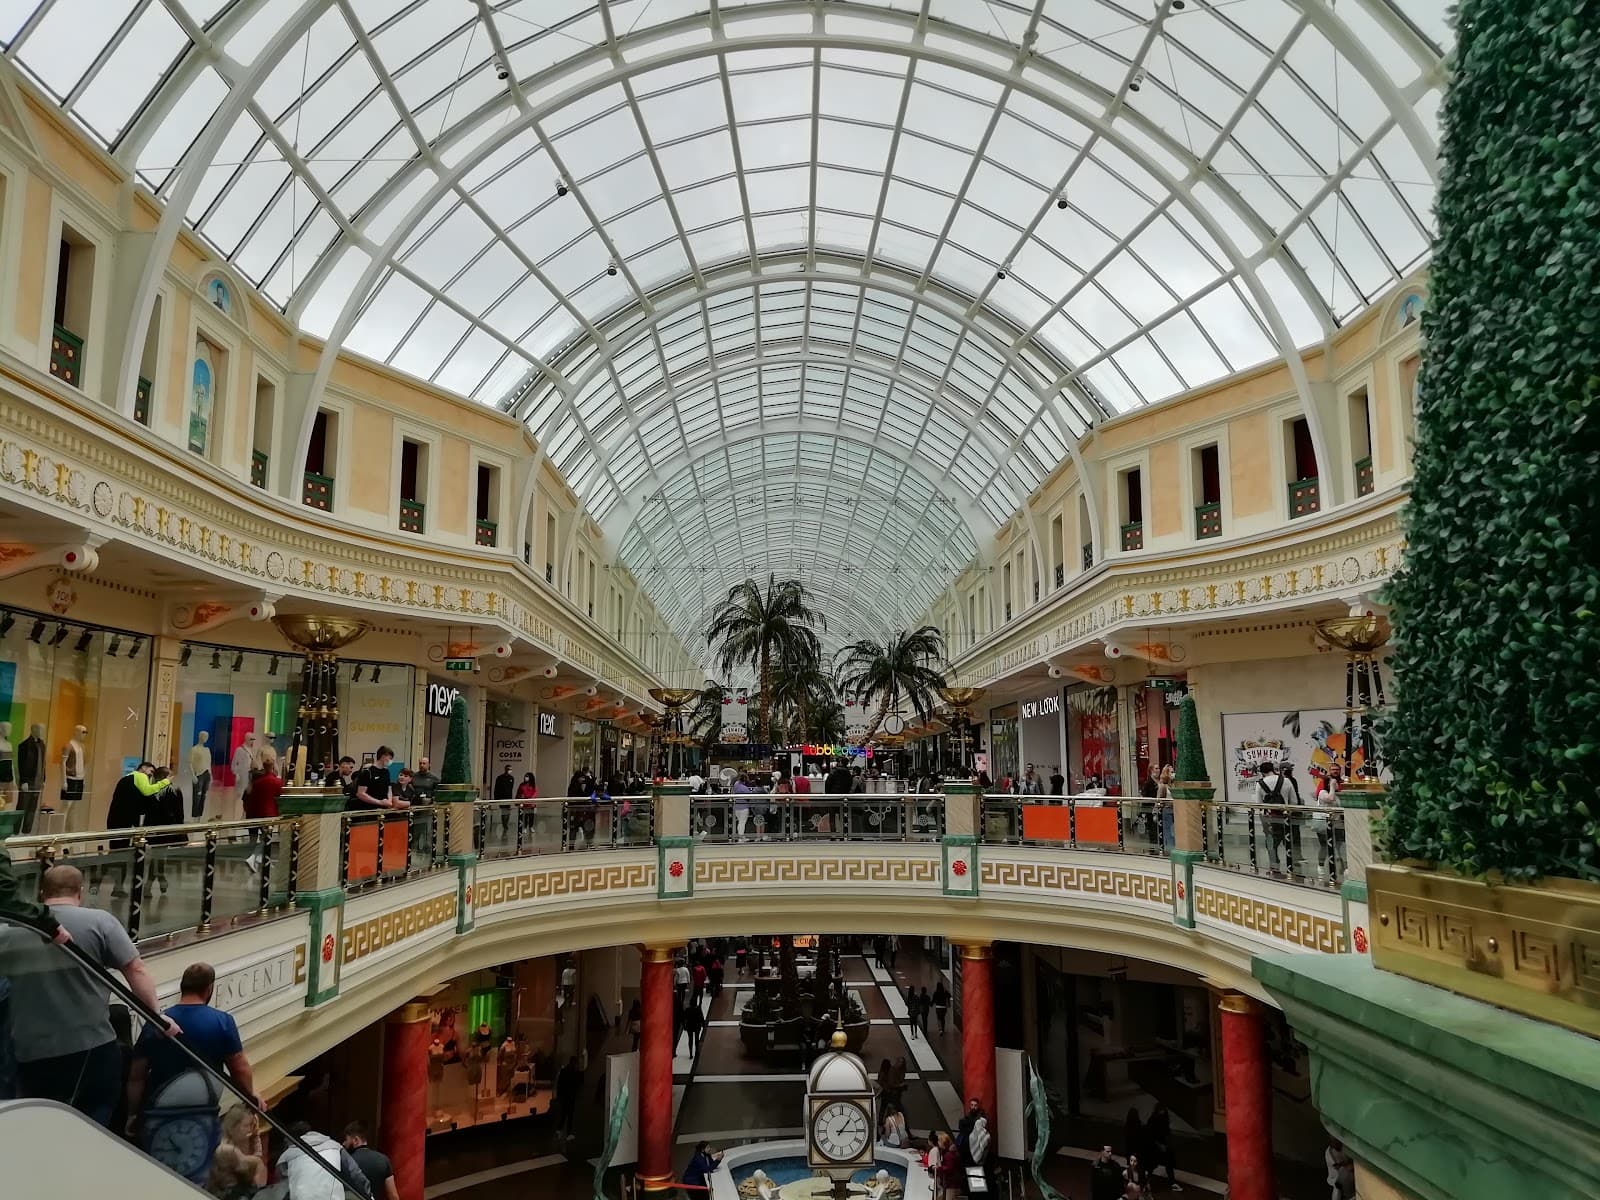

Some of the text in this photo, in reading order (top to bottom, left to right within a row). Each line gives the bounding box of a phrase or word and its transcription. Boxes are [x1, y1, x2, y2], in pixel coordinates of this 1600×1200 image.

[1022, 696, 1059, 719] NEW LOOK
[540, 713, 556, 736] next
[496, 740, 525, 749] next
[1246, 749, 1279, 760] SUMMER
[215, 959, 285, 1008] ESCENT
